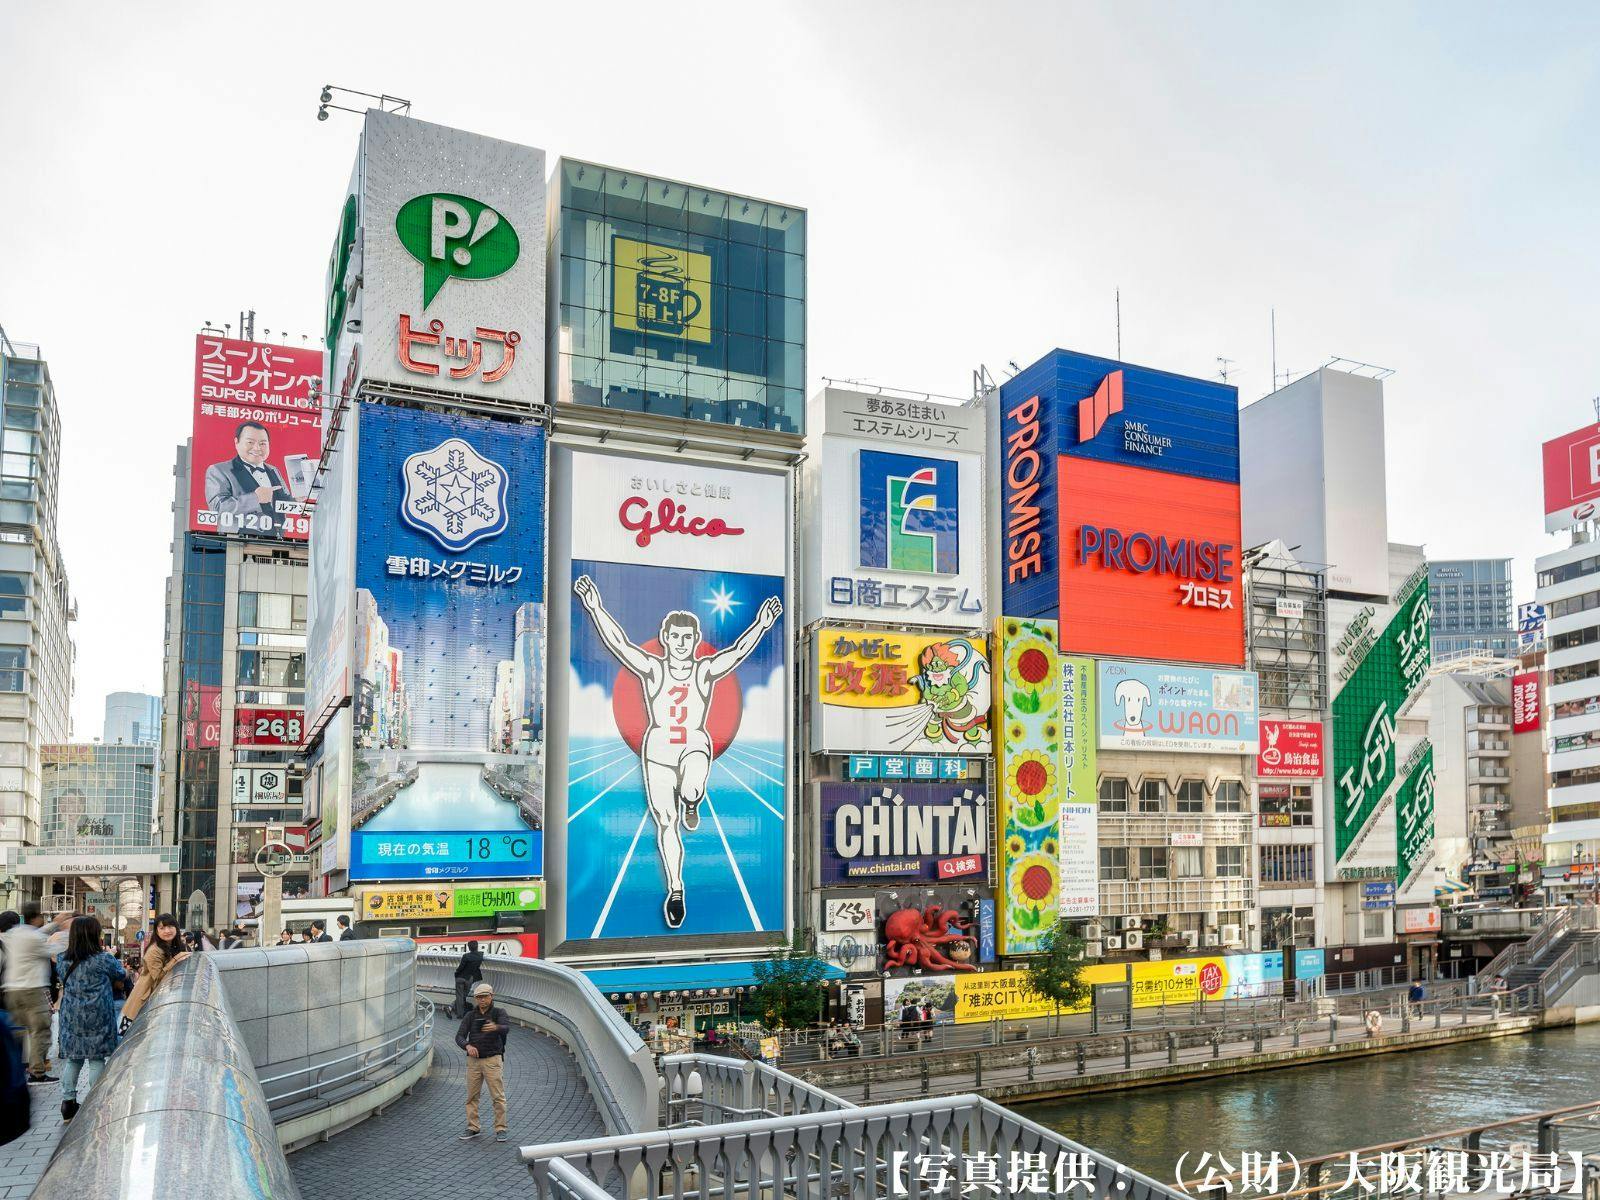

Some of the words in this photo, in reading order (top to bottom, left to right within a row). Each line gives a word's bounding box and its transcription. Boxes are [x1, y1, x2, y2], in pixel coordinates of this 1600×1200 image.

[203, 340, 294, 367] スーパー
[397, 313, 522, 383] ピップ
[201, 385, 257, 401] SUPER
[867, 398, 945, 421] 夢ある住まい
[853, 418, 959, 445] エステムシリーズ
[1124, 419, 1149, 434] SMBC
[1124, 431, 1173, 448] CONSUMER
[1125, 441, 1163, 456] FINANCE
[631, 475, 732, 500] おいしさと健康
[1007, 395, 1041, 584] PROMISE
[1079, 524, 1234, 582] PROMISE
[386, 555, 523, 583] 雪印メグミルク
[830, 577, 983, 613] 日商エステム
[1179, 582, 1234, 609] プロミス
[832, 635, 902, 660] かぜに
[824, 661, 910, 697] 改源
[667, 683, 691, 745] グリコ
[1158, 710, 1239, 737] WAON
[1063, 664, 1075, 799] 株式会社日本リート
[855, 758, 962, 776] 戸堂歯科
[1339, 700, 1400, 828] エイブル
[378, 842, 450, 857] 現在の気温
[466, 837, 491, 860] 18
[955, 858, 977, 873] 検索
[1202, 966, 1219, 979] TAX
